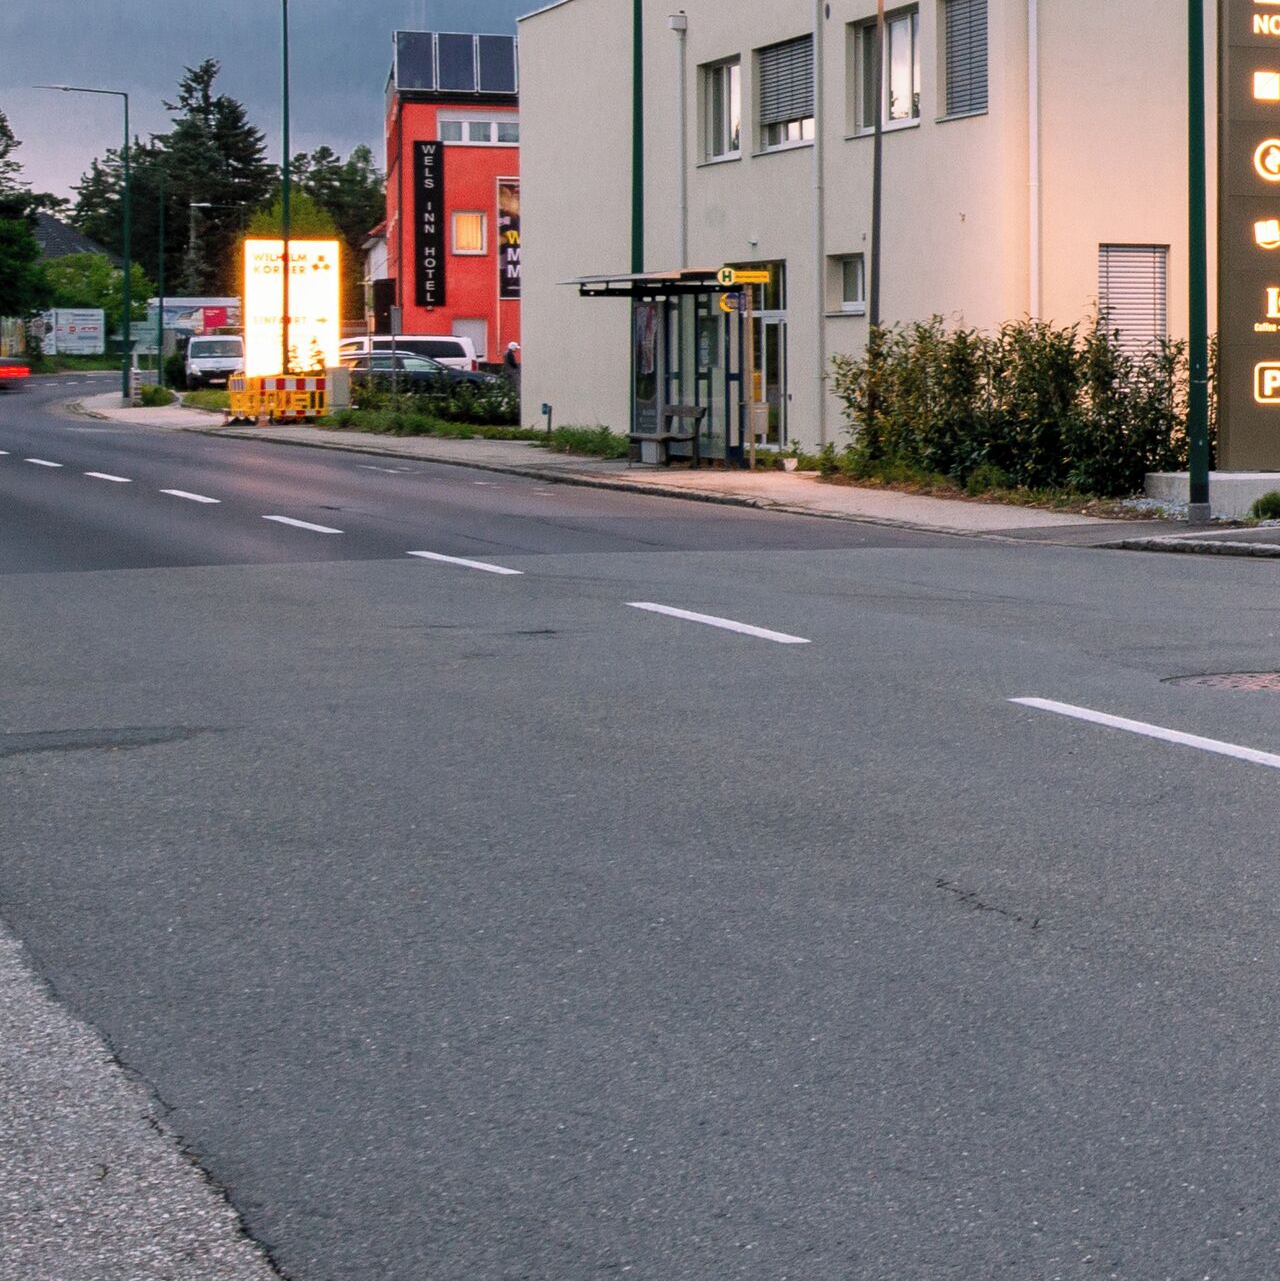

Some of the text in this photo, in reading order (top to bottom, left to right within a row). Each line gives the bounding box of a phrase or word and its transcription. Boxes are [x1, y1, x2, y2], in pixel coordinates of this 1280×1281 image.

[421, 145, 436, 302] WELS INN HOTEL
[254, 253, 307, 262] WILHLM
[254, 265, 305, 274] KORER
